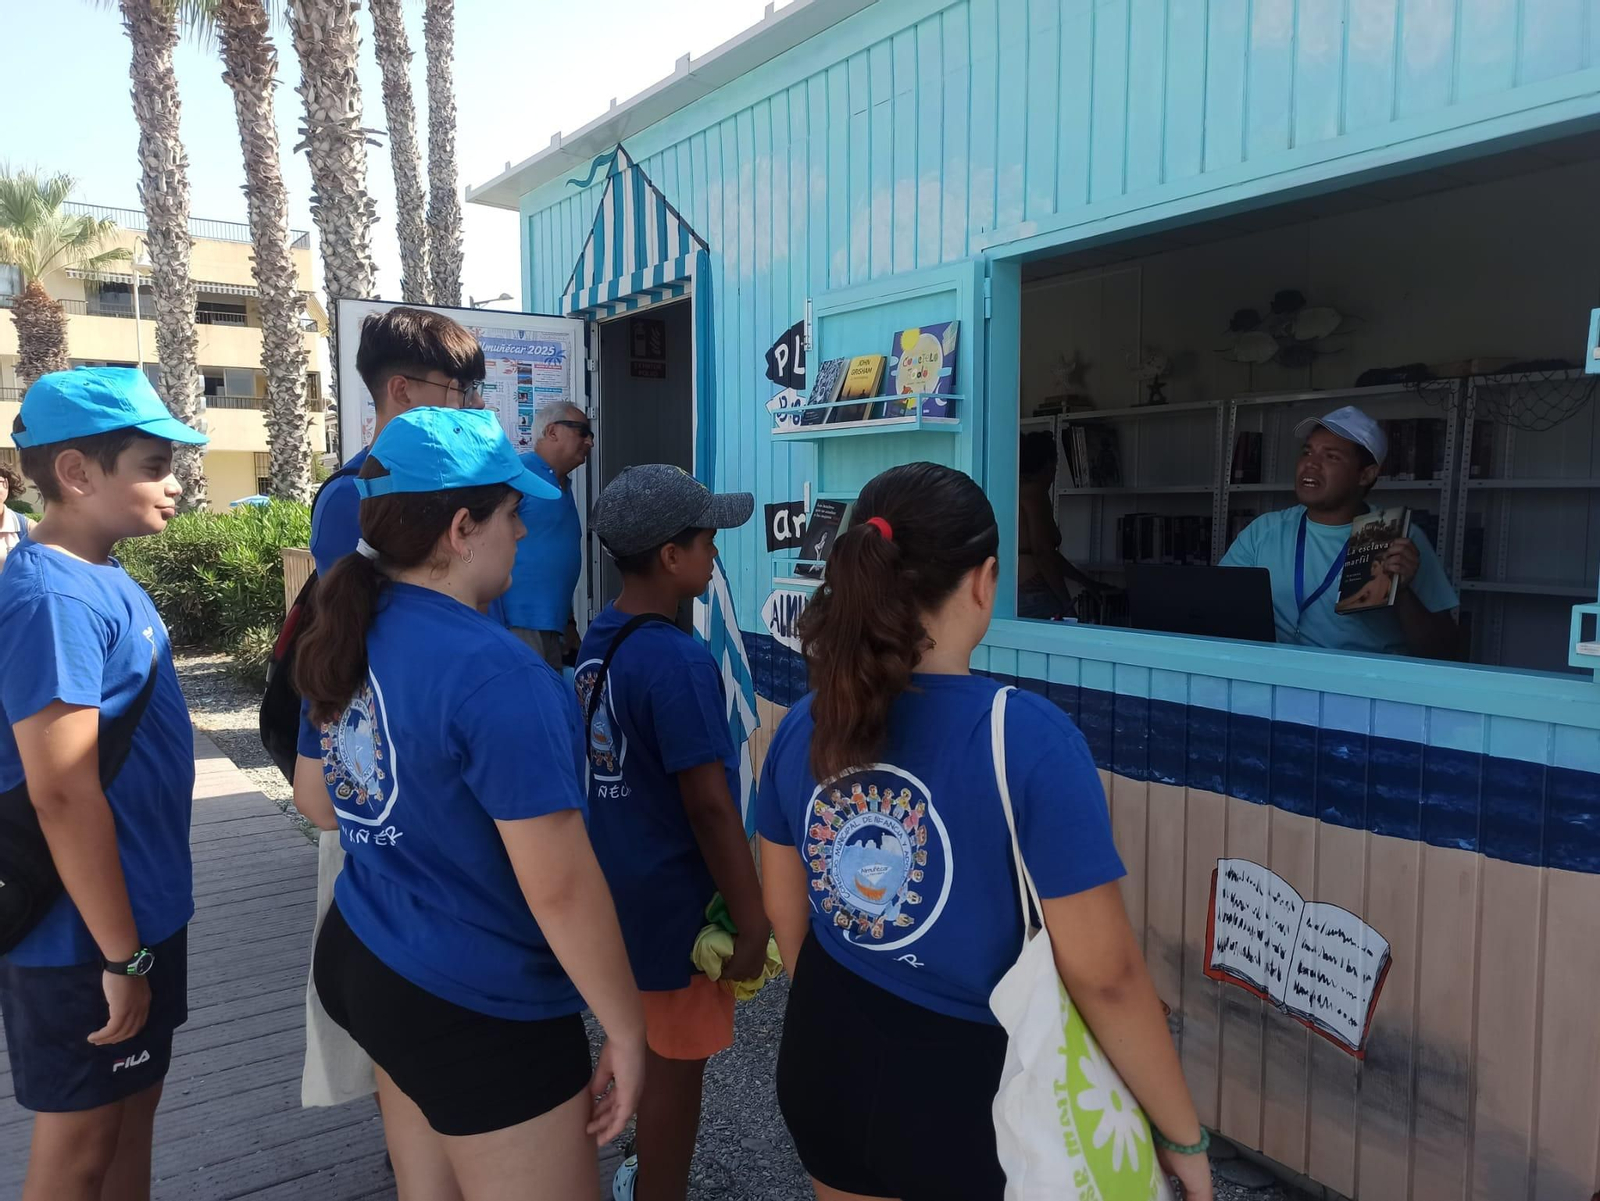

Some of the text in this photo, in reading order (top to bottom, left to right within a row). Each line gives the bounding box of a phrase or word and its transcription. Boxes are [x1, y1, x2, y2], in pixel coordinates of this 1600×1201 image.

[481, 341, 555, 355] lmuñécar 2025
[857, 359, 871, 367] JOHN
[851, 367, 873, 376] GRISHAM
[1346, 541, 1389, 556] La esclava
[1344, 554, 1370, 568] marfil
[112, 1050, 151, 1072] FILA
